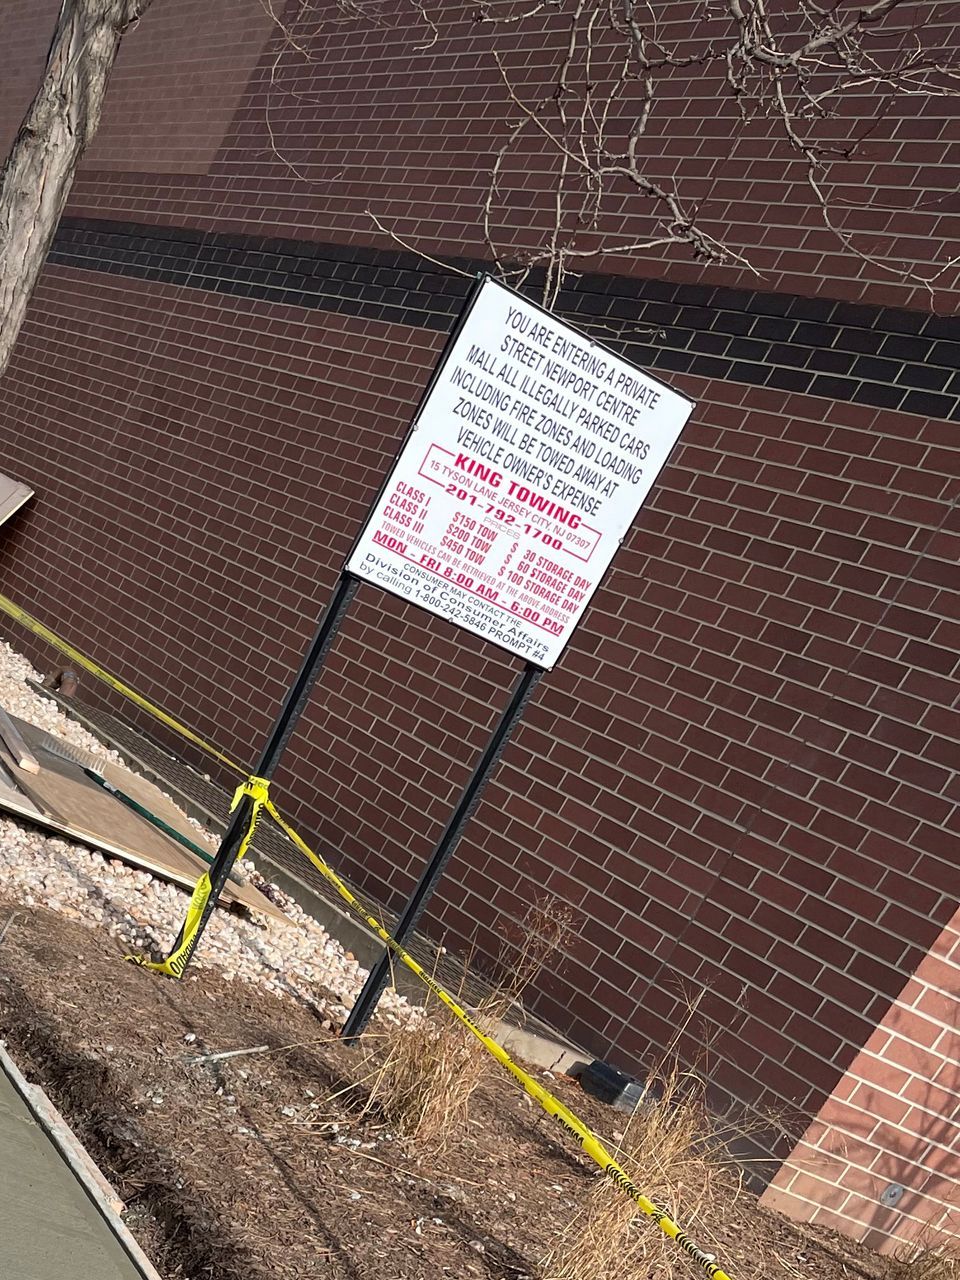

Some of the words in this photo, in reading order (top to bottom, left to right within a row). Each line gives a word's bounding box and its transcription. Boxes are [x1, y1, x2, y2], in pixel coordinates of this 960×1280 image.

[465, 344, 498, 376] MALL
[495, 363, 520, 389] ALL
[518, 374, 580, 420] ILLEGALLY
[575, 407, 621, 444] PARKED
[619, 432, 651, 461] CARS
[500, 334, 546, 372] STREET
[541, 358, 599, 402] NEWPORT
[596, 390, 641, 427] CENTRE
[505, 305, 532, 334] YOU
[526, 322, 555, 349] ARE
[551, 335, 607, 379] ENTERING
[603, 367, 616, 386] A
[614, 372, 661, 411] PRIVATE
[449, 365, 512, 412] INCLUDING
[508, 399, 538, 427] FIRE
[534, 413, 574, 447] ZONES
[569, 434, 597, 459] AND
[593, 447, 643, 485] LOADING
[452, 396, 494, 430] ZONES
[491, 417, 519, 446] WILL
[517, 433, 538, 455] BE
[535, 441, 576, 475] TOWED
[571, 463, 607, 491] AWAY
[600, 479, 620, 499] AT
[456, 425, 505, 465] VEHICLE
[502, 452, 554, 491] OWNER'S
[550, 478, 603, 517] EXPENSE
[395, 480, 426, 504] CLASS
[424, 496, 432, 507] I
[452, 511, 477, 531] $150
[476, 523, 499, 542] TOW
[522, 549, 537, 563] 30
[535, 555, 575, 583] STORAGE
[573, 575, 593, 592] DAY
[430, 459, 441, 472] 15
[441, 465, 474, 489] TYSON
[473, 482, 499, 502] LANE
[497, 496, 532, 519] JERSEY
[530, 513, 553, 532] CITY,
[552, 524, 567, 537] NJ
[565, 531, 591, 550] 07307
[445, 483, 563, 551] 201-792-1700
[454, 452, 503, 488] KING
[507, 480, 582, 530] TOWING
[482, 515, 521, 541] PRICES
[372, 529, 408, 554] MON
[419, 554, 442, 572] FRI
[443, 566, 475, 589] 8:00
[475, 583, 500, 602] AM
[510, 600, 541, 623] 6:00
[541, 617, 565, 635] PM
[381, 520, 406, 539] TOWED
[405, 533, 438, 556] VEHICLES
[436, 549, 453, 563] CAN
[451, 557, 462, 569] BE
[461, 562, 497, 586] RETRIEVED
[495, 580, 507, 591] AT
[505, 585, 519, 598] THE
[517, 592, 541, 609] ABOVE
[539, 603, 571, 624] ADDRESS
[382, 505, 413, 528] CLASS
[411, 520, 425, 535] III
[439, 535, 465, 555] $450
[464, 547, 486, 566] TOW
[506, 570, 525, 586] 100
[523, 579, 562, 606] STORAGE
[560, 598, 580, 615] DAY
[389, 492, 419, 516] CLASS
[418, 508, 429, 521] II
[446, 523, 471, 543] $200
[470, 535, 493, 554] TOW
[516, 560, 531, 574] 60
[529, 567, 569, 594] STORAGE
[566, 587, 586, 603] DAY
[403, 563, 450, 591] CONSUMER
[449, 586, 468, 600] MAY
[467, 595, 506, 619] CONTACT
[505, 614, 523, 629] THE
[359, 560, 375, 575] by
[376, 571, 413, 595] calling
[415, 589, 488, 632] 1-800-242-5846
[487, 626, 533, 654] PROMPT
[531, 649, 545, 661] #4
[365, 552, 420, 586] Division
[422, 584, 438, 594] of
[439, 591, 506, 629] Consumer
[507, 626, 550, 653] Affairs
